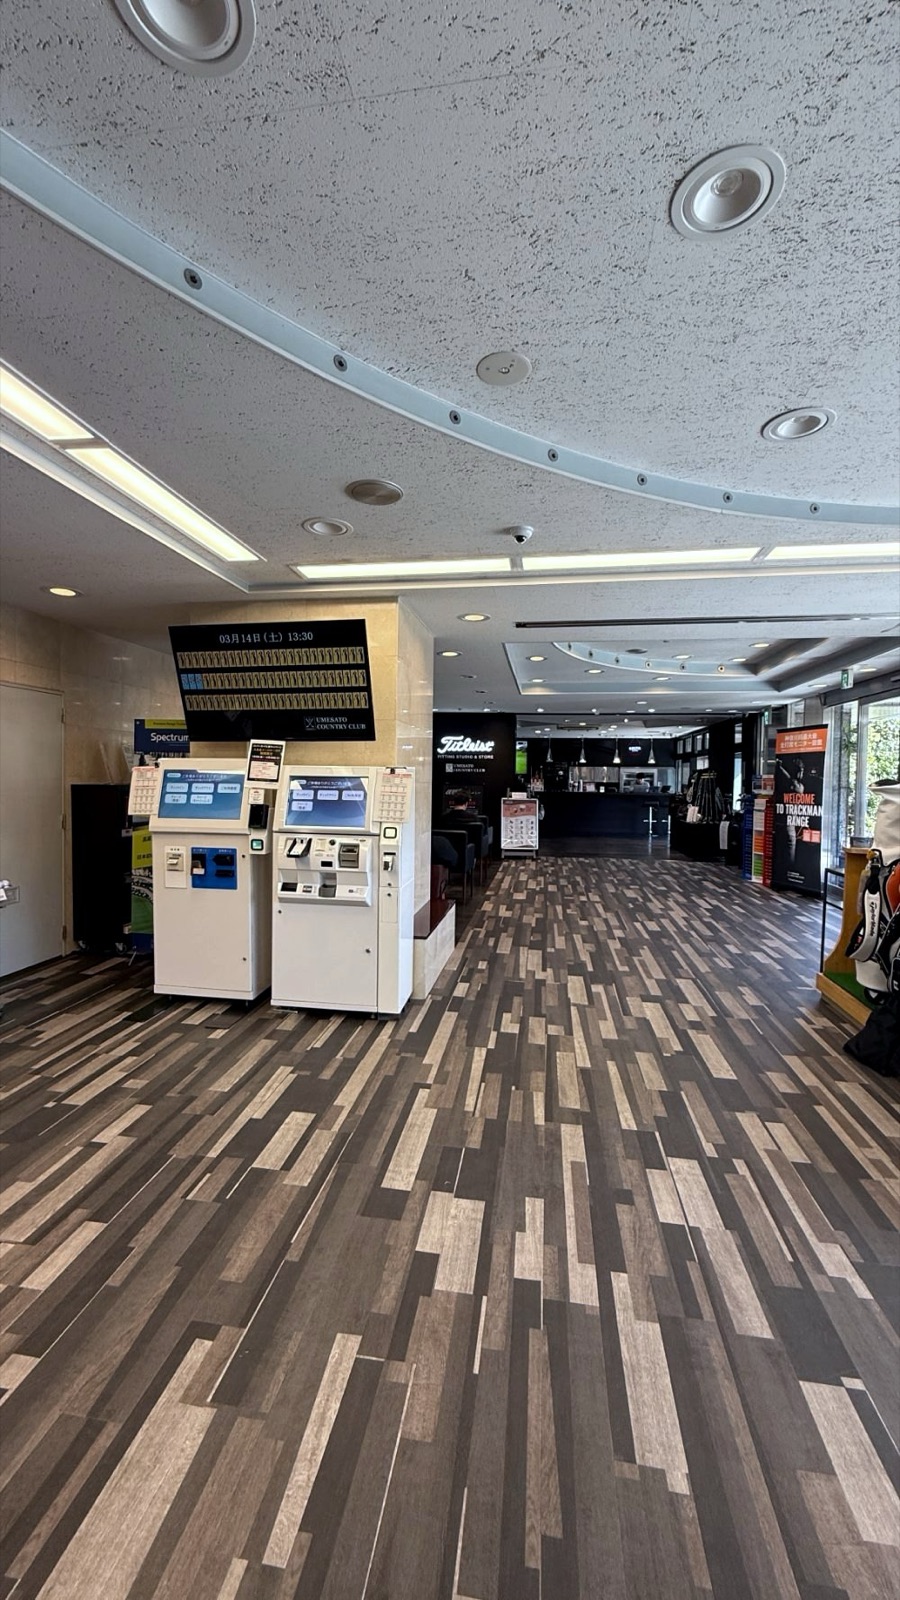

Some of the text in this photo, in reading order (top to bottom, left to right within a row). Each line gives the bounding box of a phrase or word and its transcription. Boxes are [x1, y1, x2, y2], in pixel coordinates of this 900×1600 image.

[288, 632, 314, 642] 13:30
[436, 735, 495, 754] Titleist
[783, 793, 815, 805] WELCOME
[776, 804, 823, 817] TO TRACKMAN
[786, 816, 810, 828] RANGE
